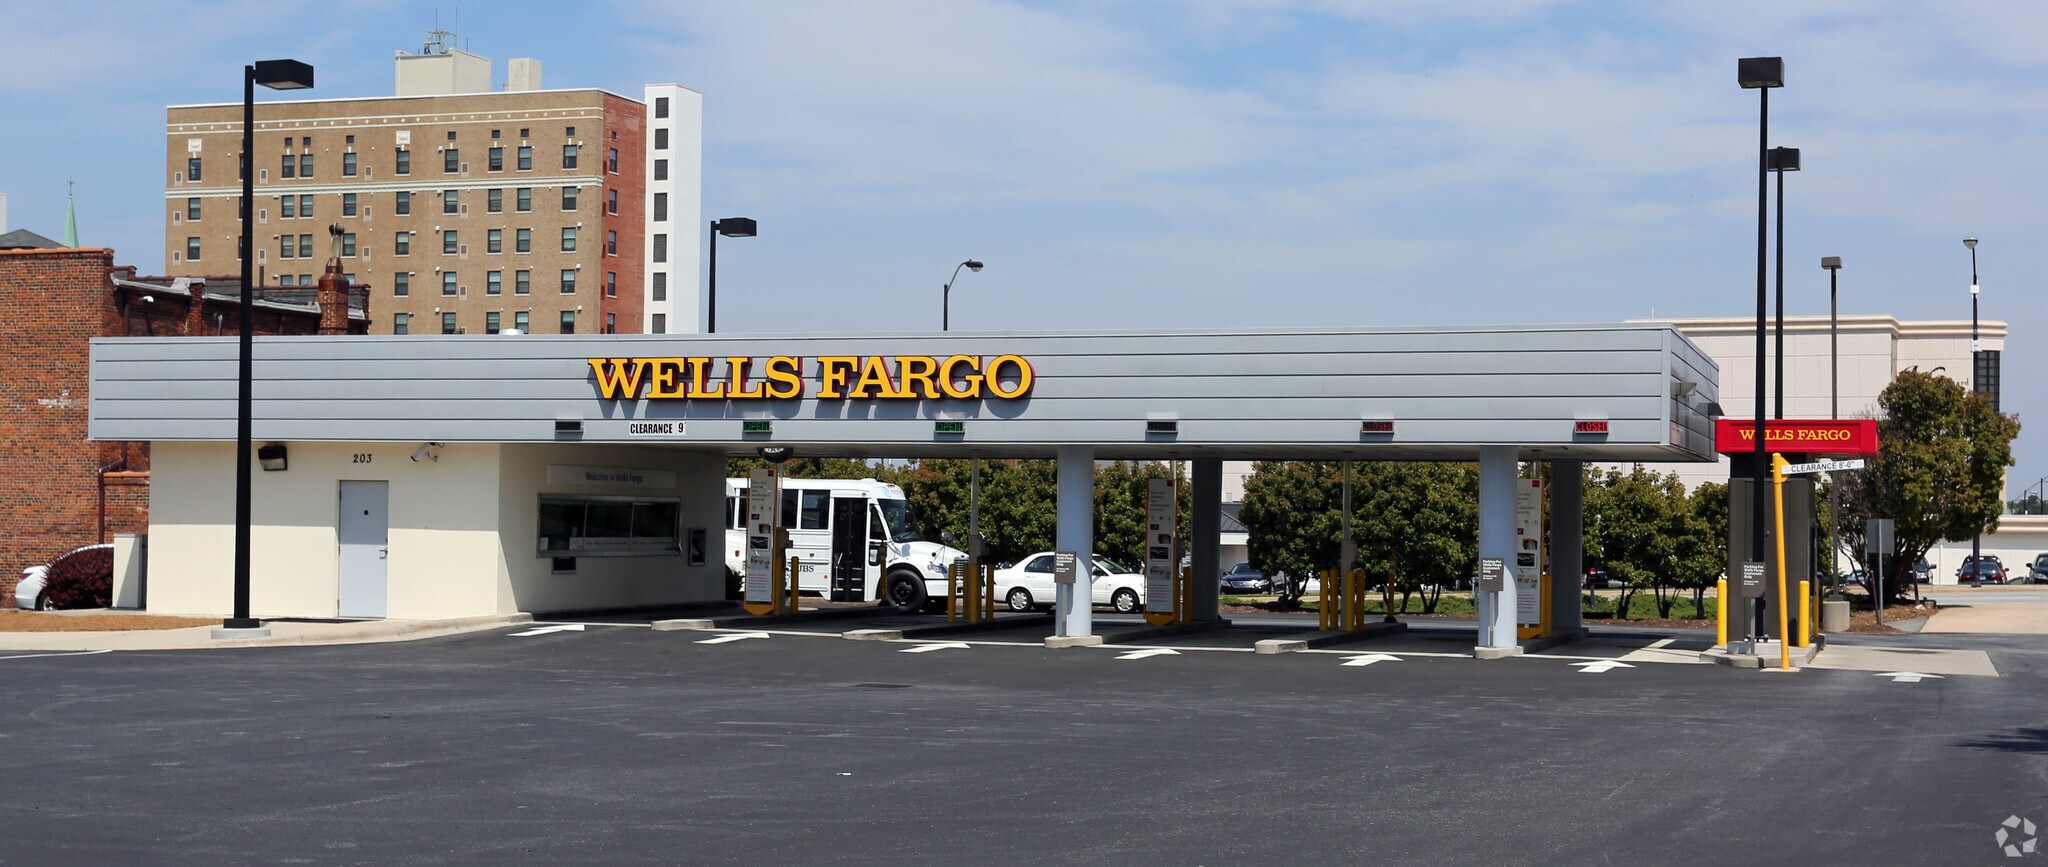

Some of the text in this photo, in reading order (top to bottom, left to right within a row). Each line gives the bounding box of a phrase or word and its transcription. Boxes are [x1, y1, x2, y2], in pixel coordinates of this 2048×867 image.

[587, 354, 1034, 400] WELLS FARGO
[630, 423, 672, 434] CLEARANCE
[744, 421, 769, 431] OPEN
[936, 421, 962, 432] OPEN
[1739, 429, 1851, 441] WLLS FARGO
[353, 453, 372, 463] 203
[1790, 462, 1837, 473] CLEARANCE
[586, 472, 610, 481] Welcome
[616, 472, 628, 482] Wells
[629, 473, 644, 484] Fargo
